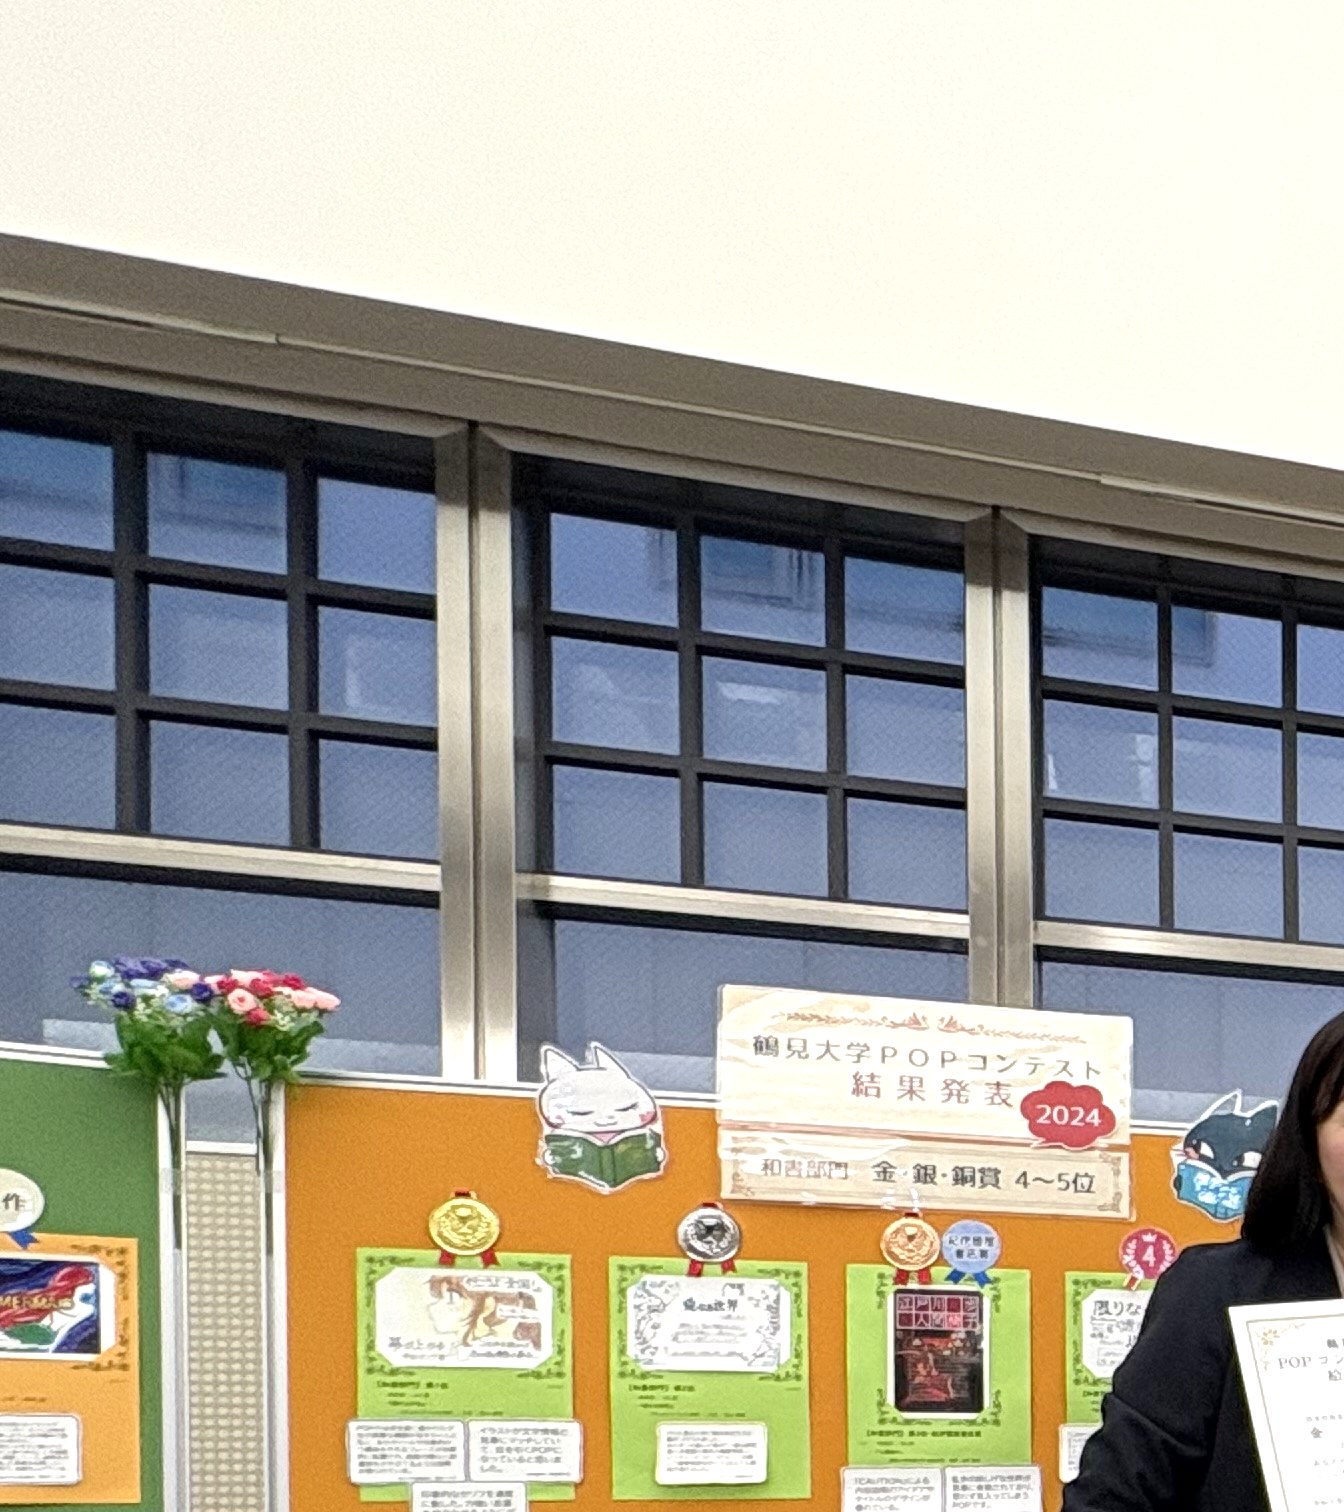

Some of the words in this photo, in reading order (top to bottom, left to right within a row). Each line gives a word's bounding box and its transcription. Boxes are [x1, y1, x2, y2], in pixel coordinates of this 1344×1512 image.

[753, 1034, 1102, 1078] 鶴見大学POPコンテスト
[851, 1071, 1013, 1108] 結果発表
[1036, 1103, 1102, 1127] 2024
[1142, 1244, 1157, 1267] 4
[1277, 1355, 1312, 1370] POP
